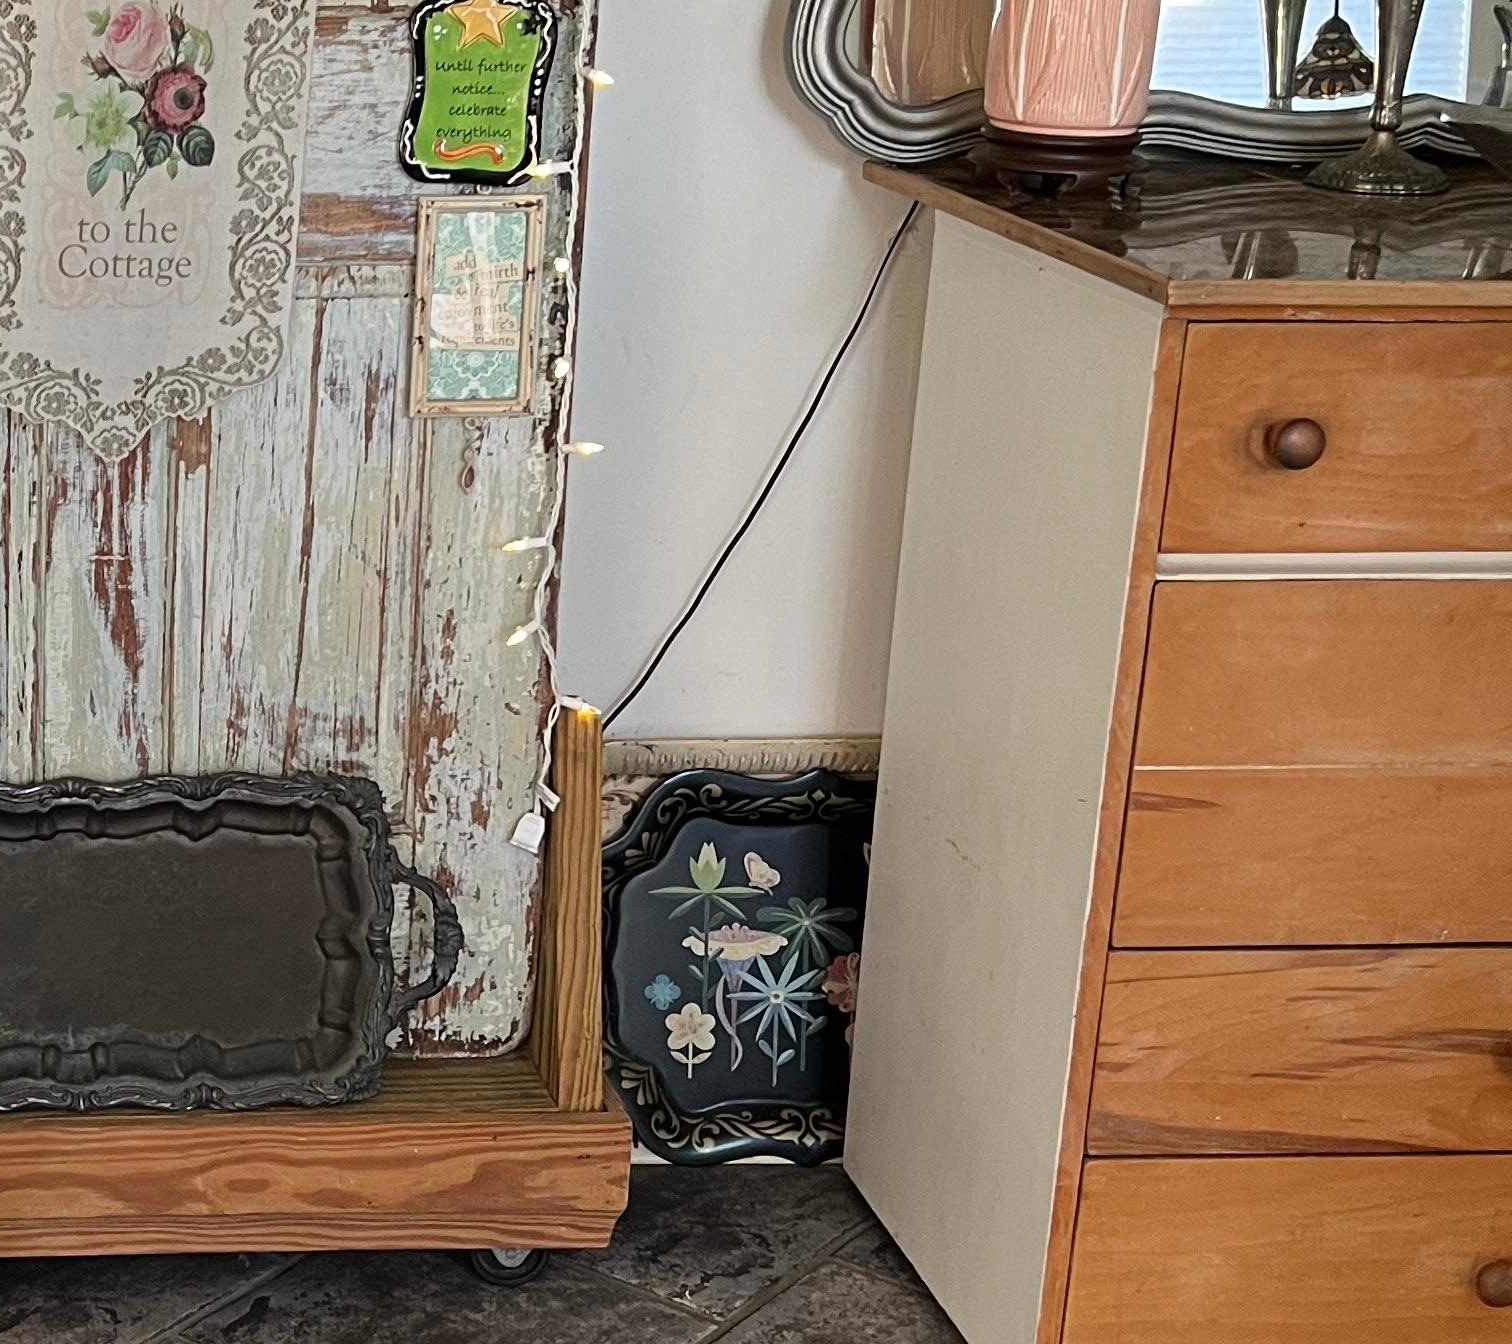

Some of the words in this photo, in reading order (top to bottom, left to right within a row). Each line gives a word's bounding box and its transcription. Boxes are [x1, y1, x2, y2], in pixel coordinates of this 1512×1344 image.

[478, 58, 528, 75] further
[449, 103, 506, 116] celebrate
[436, 126, 512, 143] everything
[78, 218, 110, 243] to
[124, 208, 178, 243] the
[58, 244, 192, 287] Cottage
